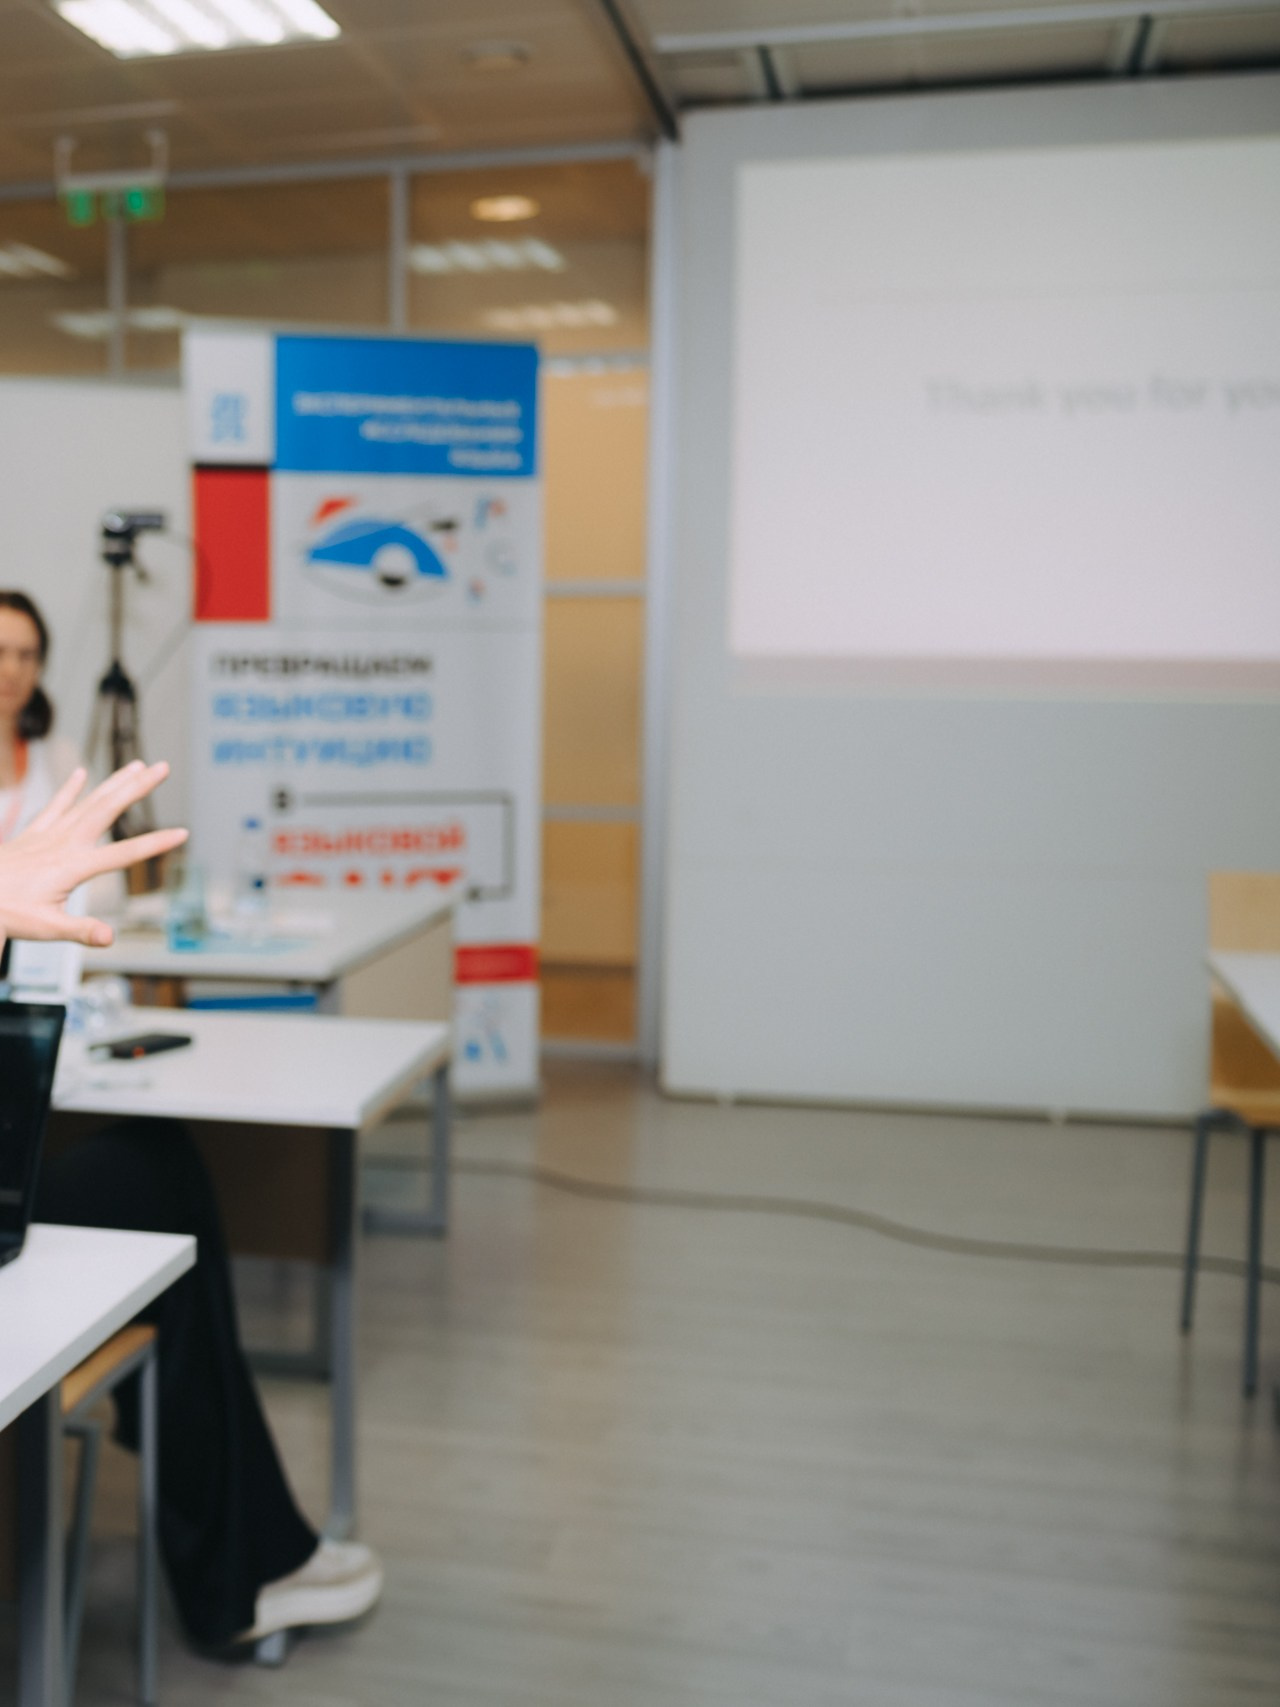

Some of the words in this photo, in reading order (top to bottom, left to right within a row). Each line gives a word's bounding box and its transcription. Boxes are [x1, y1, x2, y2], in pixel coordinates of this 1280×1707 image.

[926, 377, 1046, 412] Thank
[1059, 381, 1138, 418] you
[1149, 375, 1209, 410] for
[212, 654, 433, 680] ПРЕВРАЩАЕМ
[212, 691, 432, 720] ЯЗЫКОВУЮ
[212, 736, 432, 766] ИНТУИЦИЮ
[272, 819, 466, 856] ЯЗЫКОВОЙ
